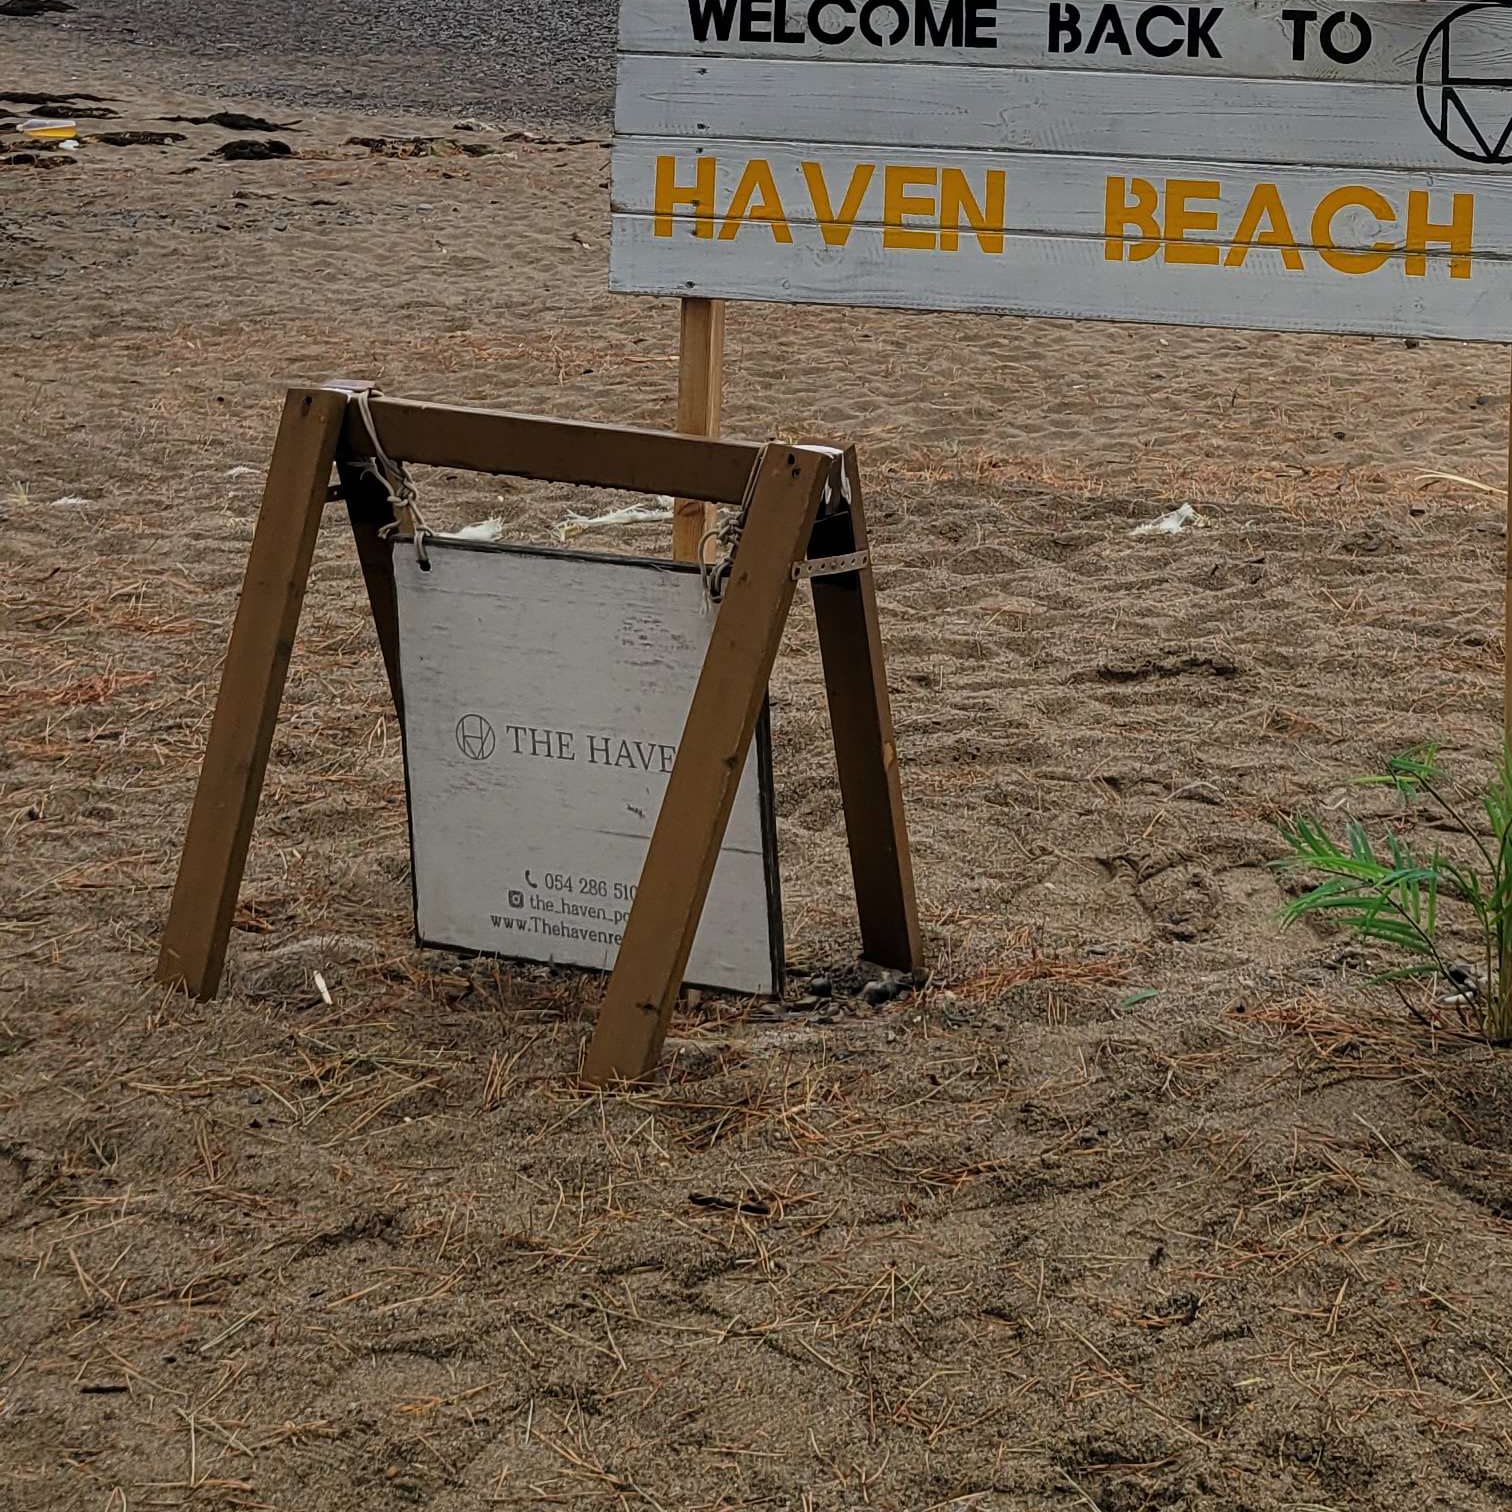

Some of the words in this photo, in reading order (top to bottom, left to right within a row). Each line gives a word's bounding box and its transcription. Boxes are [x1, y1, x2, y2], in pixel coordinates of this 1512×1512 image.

[1047, 2, 1225, 59] BACK
[1282, 9, 1372, 65] TO
[653, 155, 1006, 254] HAVEN
[1104, 177, 1474, 280] BEACH
[506, 724, 576, 761] THE
[544, 872, 574, 893] 054
[579, 877, 608, 897] 286
